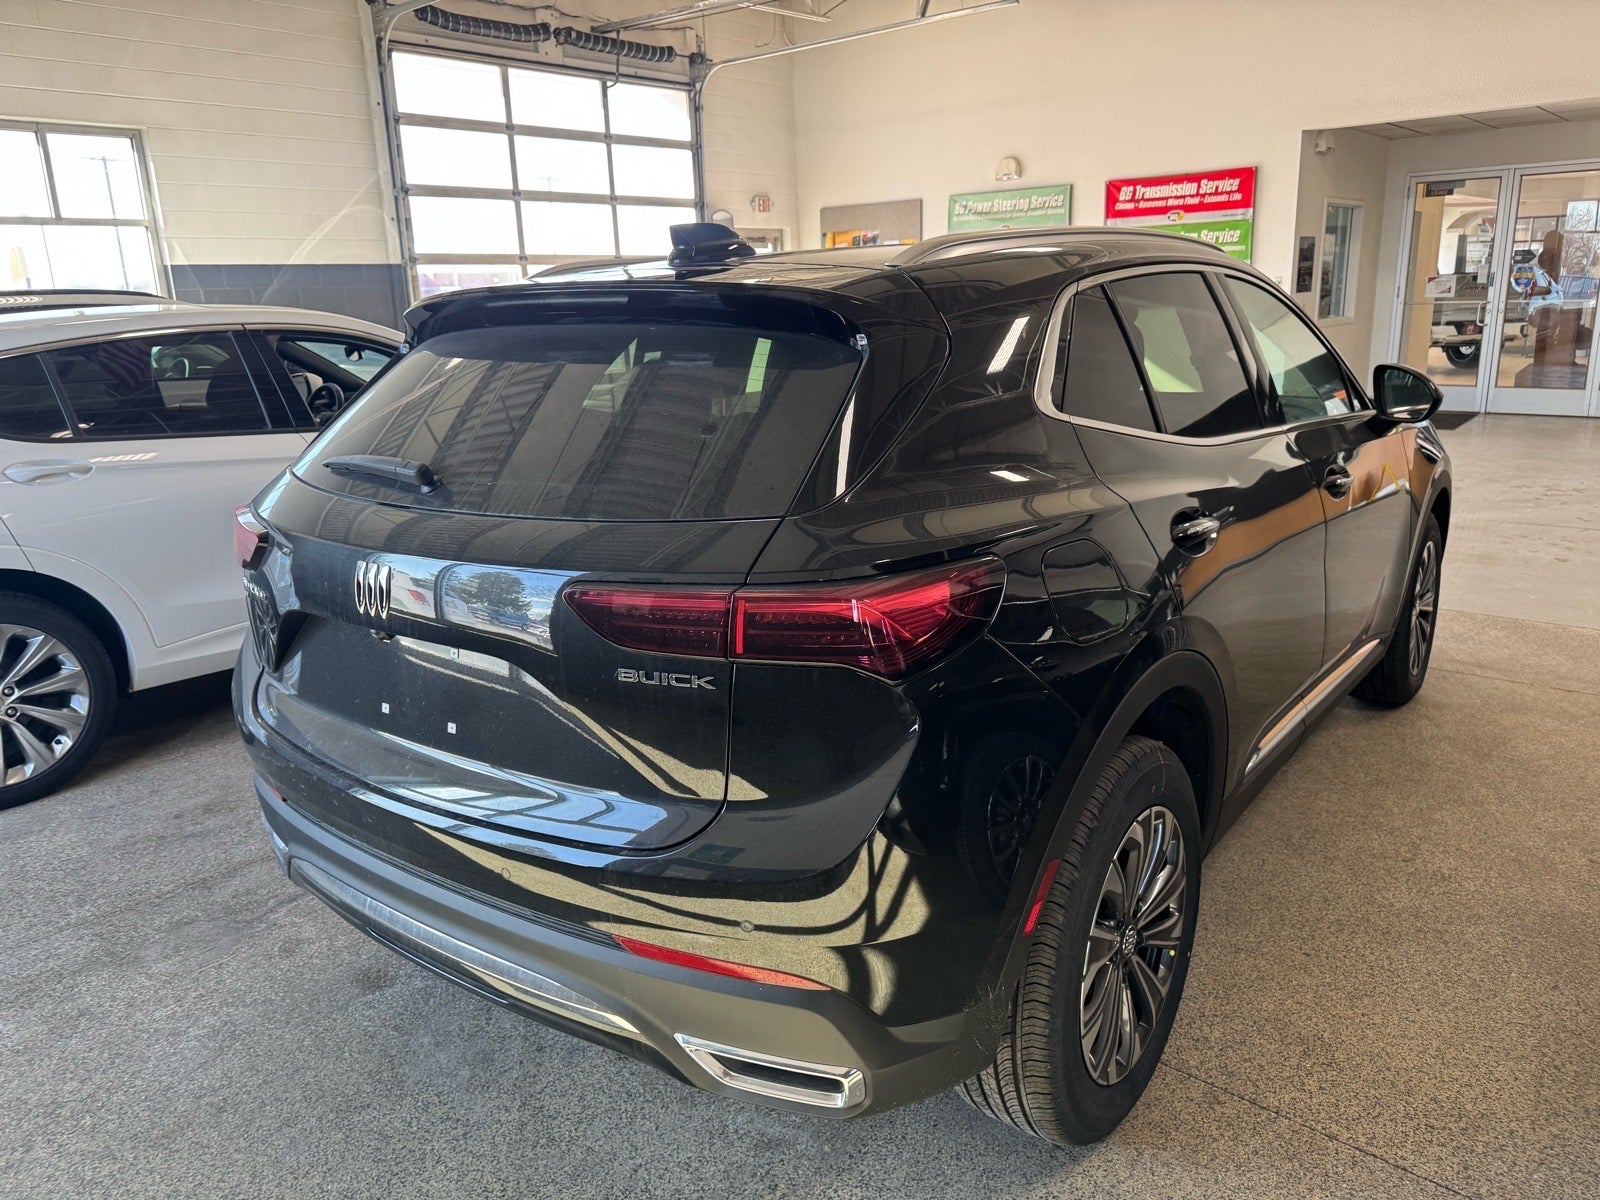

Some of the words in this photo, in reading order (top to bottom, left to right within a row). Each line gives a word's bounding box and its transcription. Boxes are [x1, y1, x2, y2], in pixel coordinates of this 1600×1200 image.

[1135, 181, 1198, 200] Transmission
[1199, 177, 1241, 194] Service
[1203, 193, 1229, 203] Extends
[966, 201, 992, 214] Power
[993, 196, 1030, 212] Steering
[1030, 193, 1064, 208] Service
[1200, 228, 1241, 244] Service
[617, 668, 716, 690] BUICK
